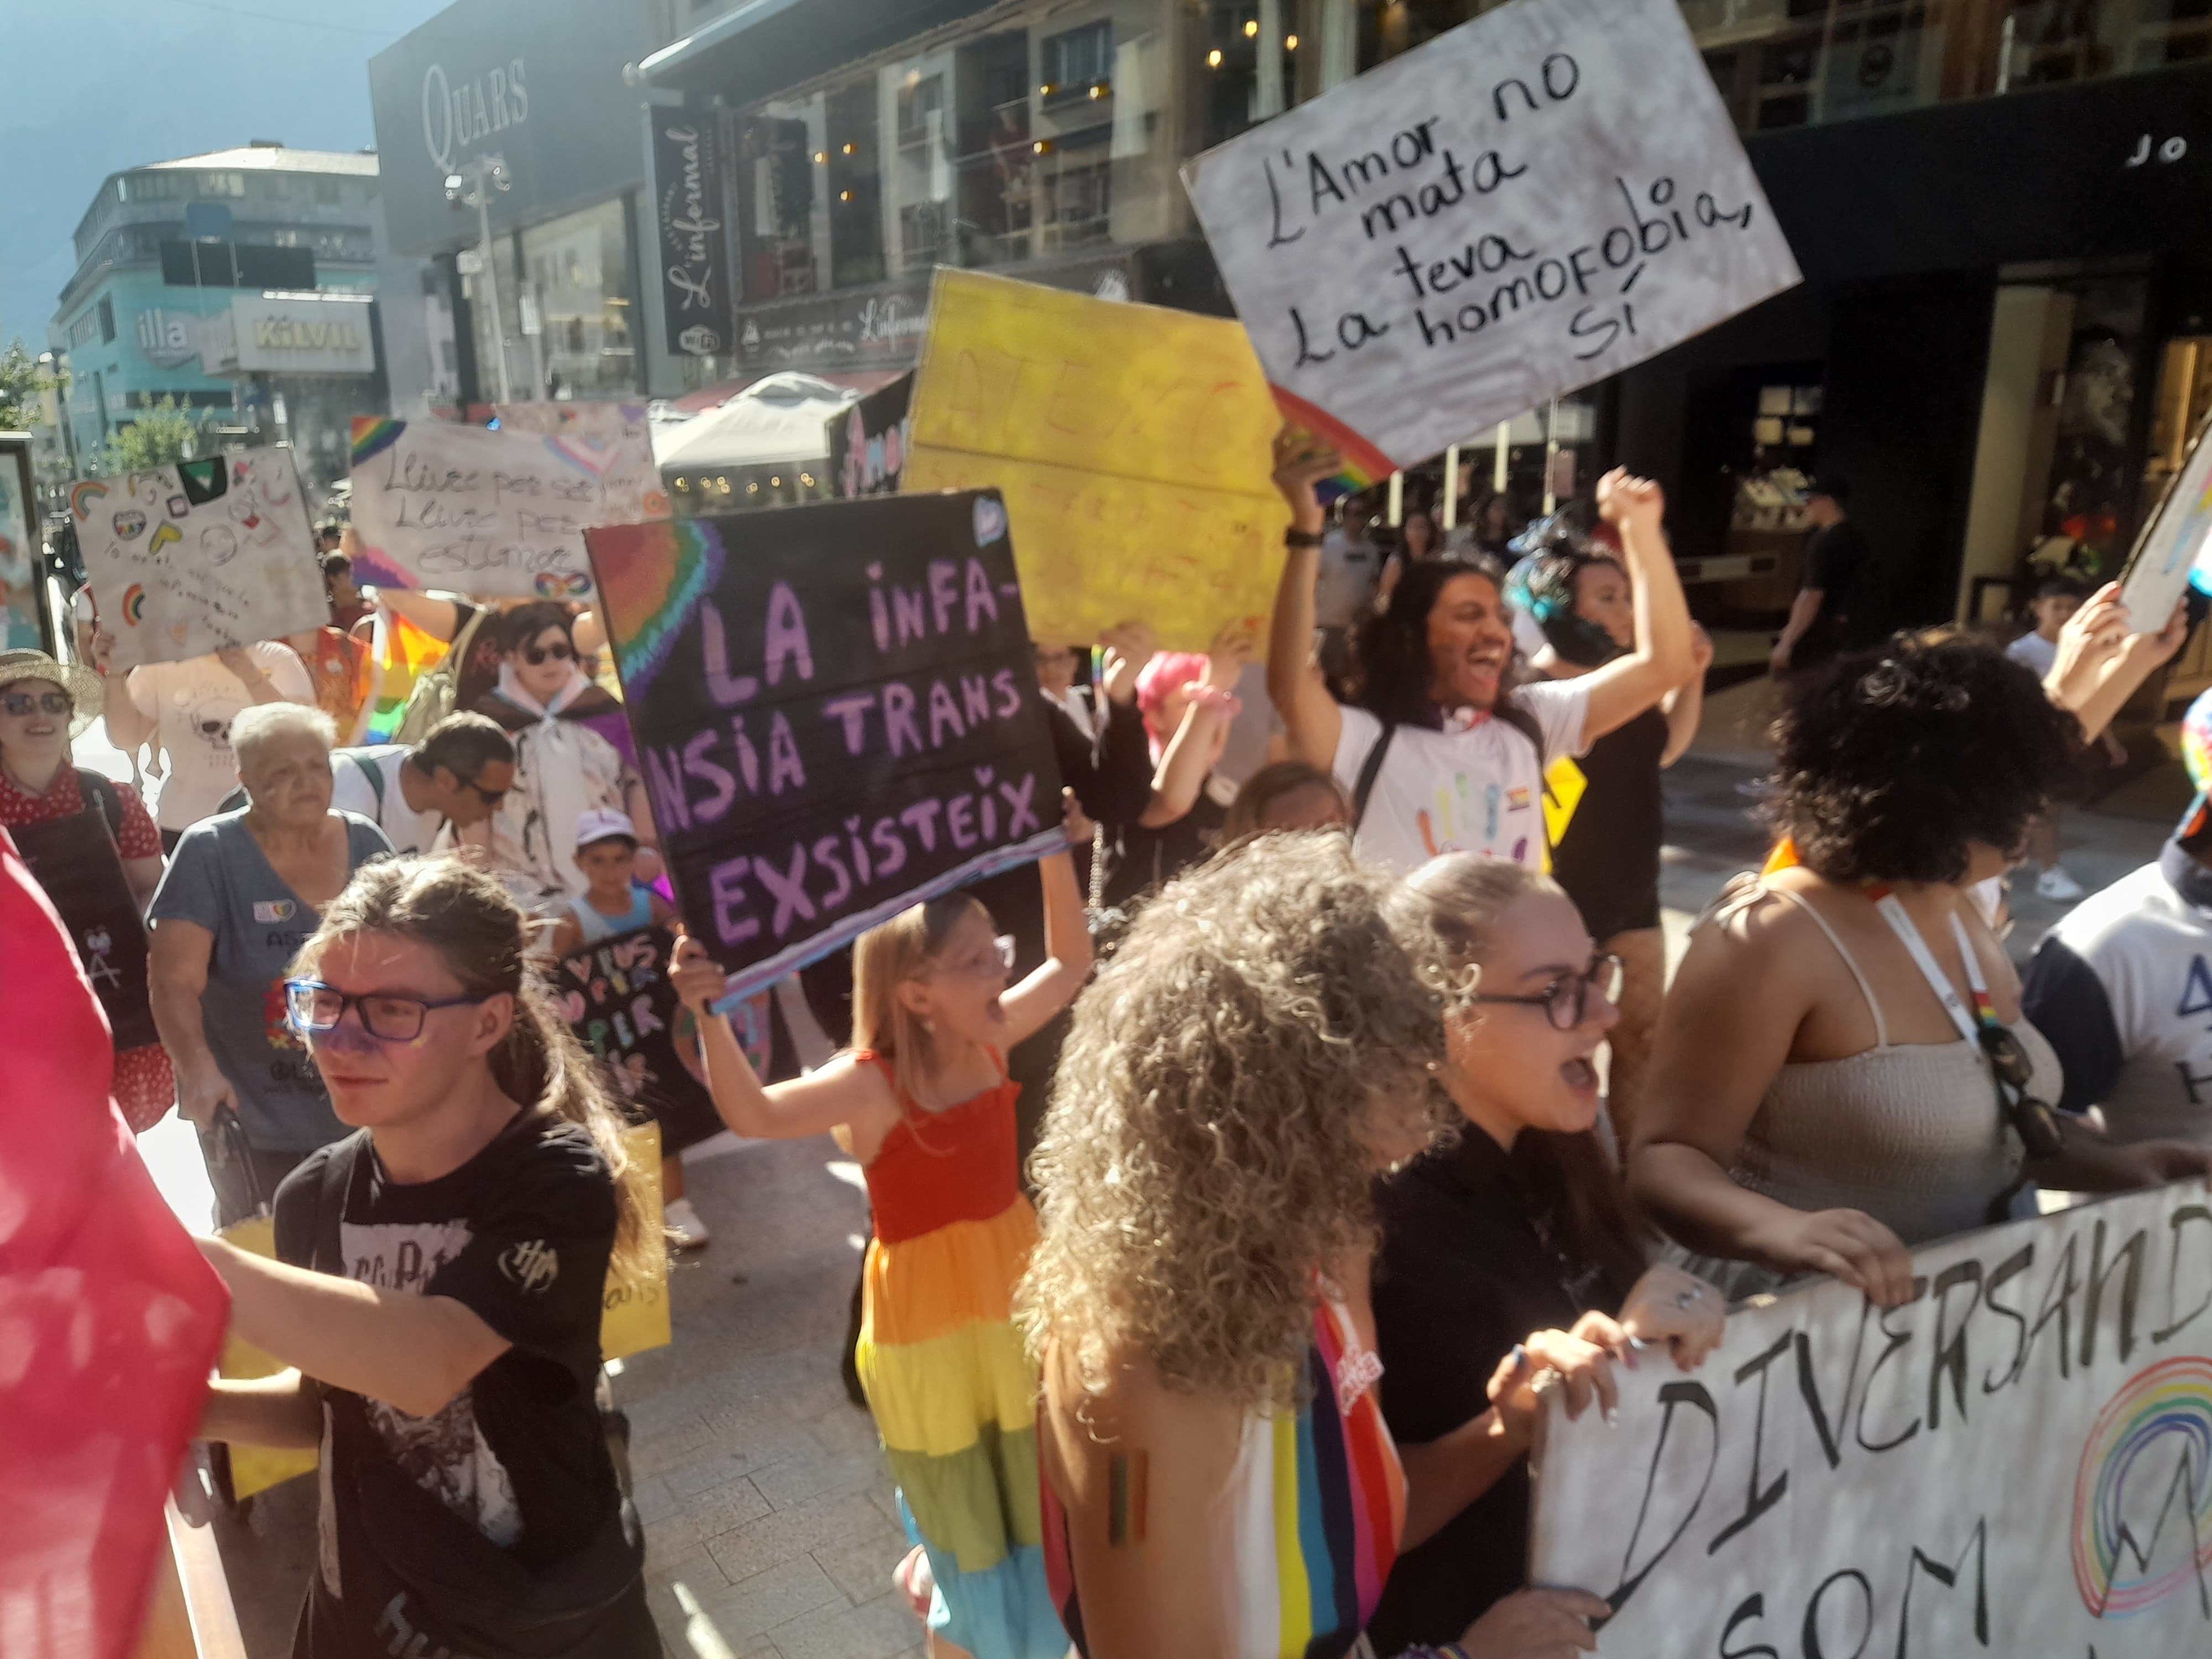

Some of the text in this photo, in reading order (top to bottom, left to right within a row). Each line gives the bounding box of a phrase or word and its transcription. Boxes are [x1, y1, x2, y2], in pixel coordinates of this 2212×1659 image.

[422, 57, 529, 174] QUARS
[1263, 53, 1580, 249] L'Amor no
[2125, 134, 2188, 168] JO
[1360, 149, 1528, 239] mata
[137, 307, 187, 349] illa
[1289, 234, 1539, 368] La teva
[701, 579, 815, 708] LA
[825, 668, 1022, 758] TRANS
[1588, 1204, 2212, 1633] DIVERSAND
